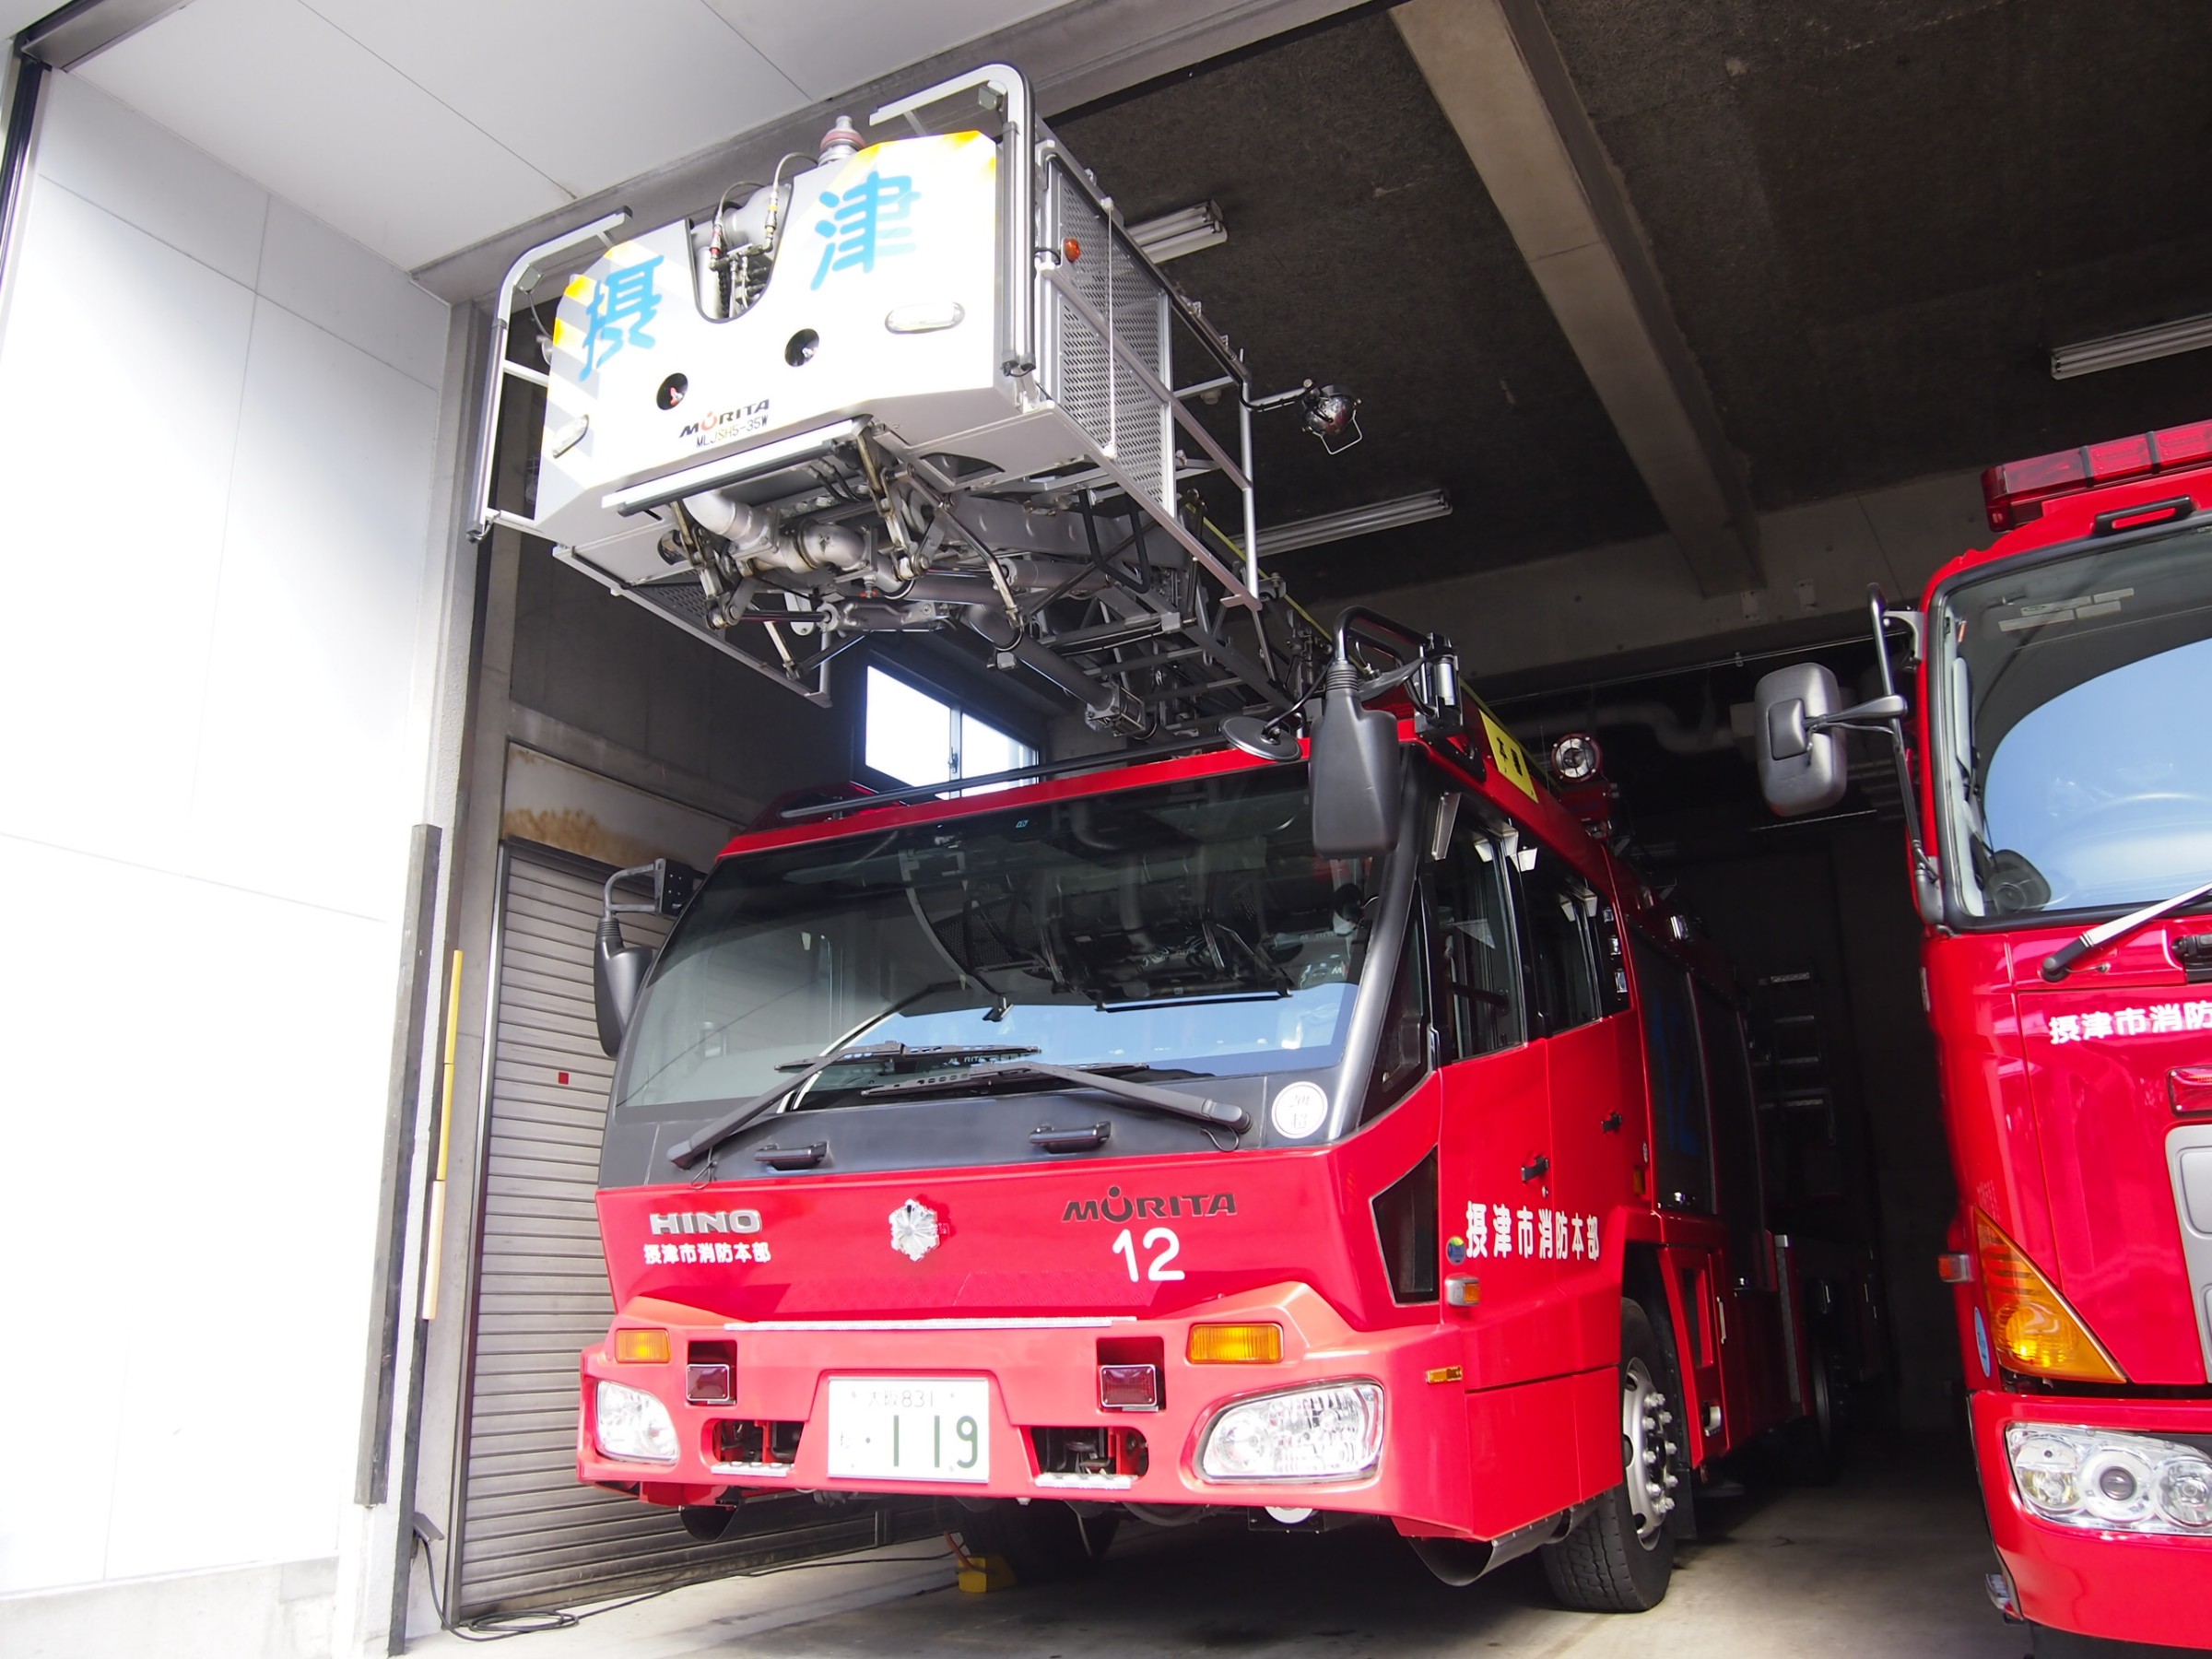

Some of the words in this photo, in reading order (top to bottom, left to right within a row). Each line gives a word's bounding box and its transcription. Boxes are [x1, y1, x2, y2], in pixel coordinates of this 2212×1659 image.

[578, 253, 665, 382] 摂
[810, 170, 922, 291] 津
[678, 399, 771, 439] MORITA
[648, 1209, 764, 1236] HINO
[1061, 1185, 1238, 1222] MORITA
[1465, 1200, 1601, 1262] 摂津市消防本部
[642, 1241, 772, 1265] 摂津市消防本部
[1111, 1227, 1187, 1283] 12
